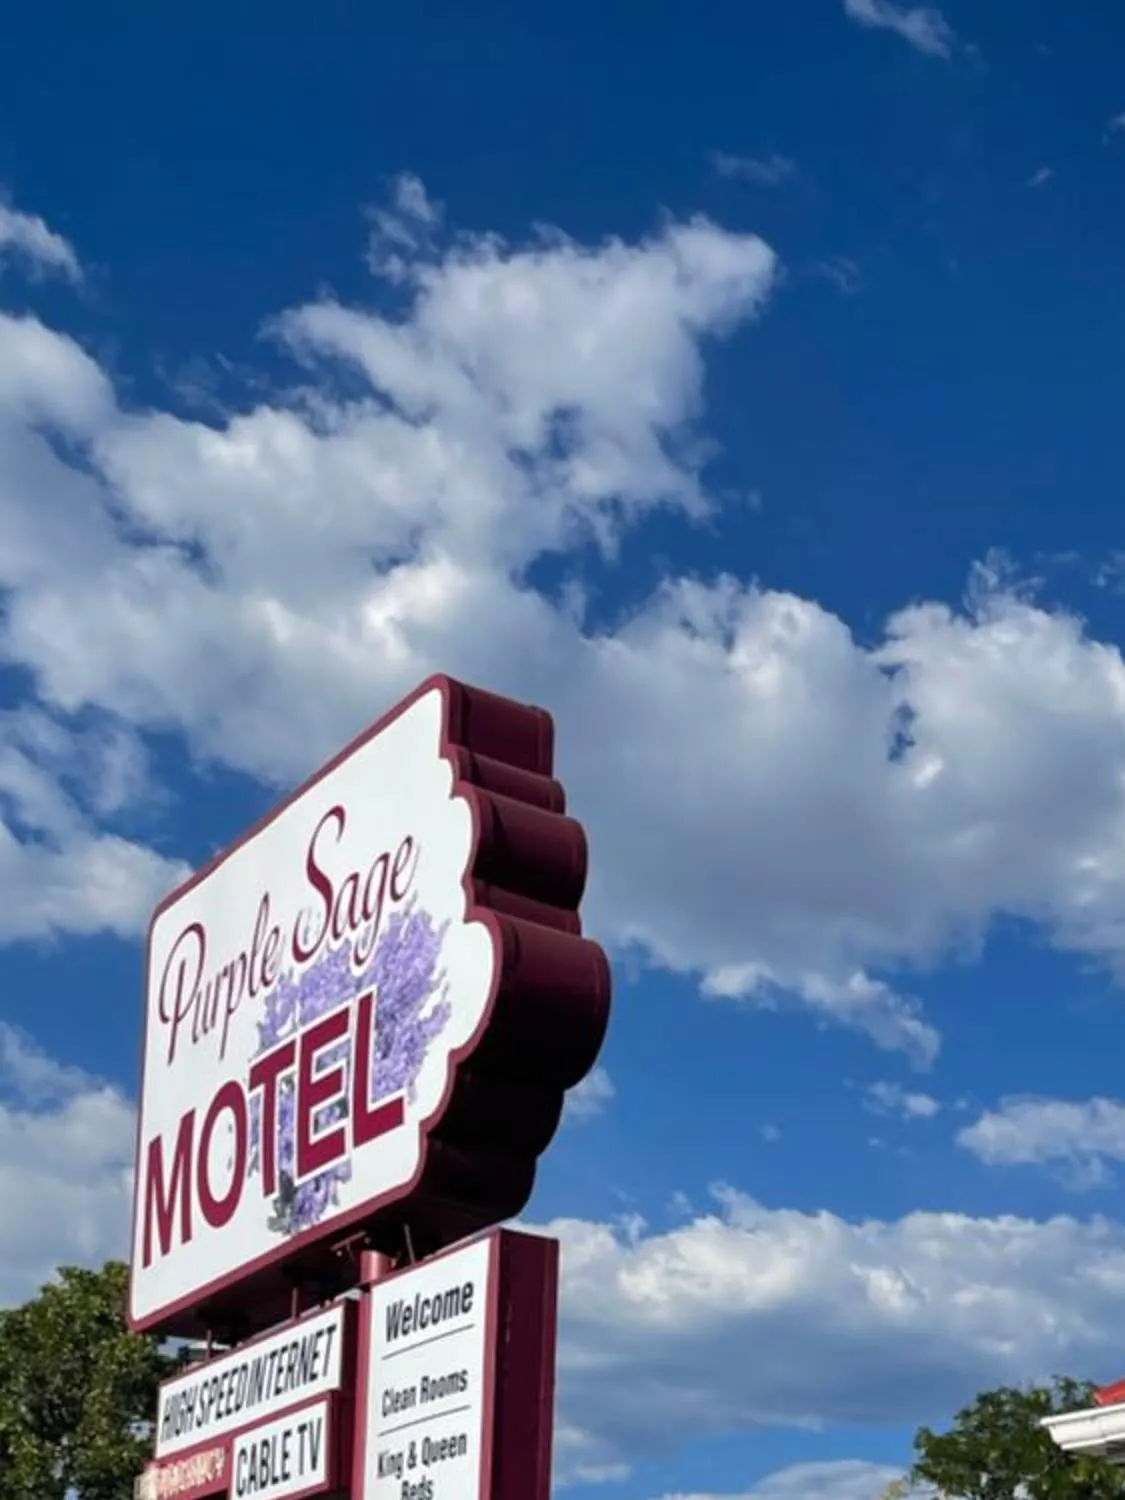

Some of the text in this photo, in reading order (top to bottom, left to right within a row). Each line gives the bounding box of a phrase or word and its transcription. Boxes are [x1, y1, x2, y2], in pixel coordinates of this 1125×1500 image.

[158, 804, 417, 1066] Purple Sage
[142, 992, 403, 1268] MOTEL
[386, 1281, 474, 1342] Welcome
[160, 1324, 337, 1443] HIGH SPEED INTERNET
[382, 1369, 468, 1418] Clean Rooms
[236, 1429, 292, 1498] CABLE
[297, 1416, 323, 1475] TV
[377, 1432, 467, 1480] King & Queen
